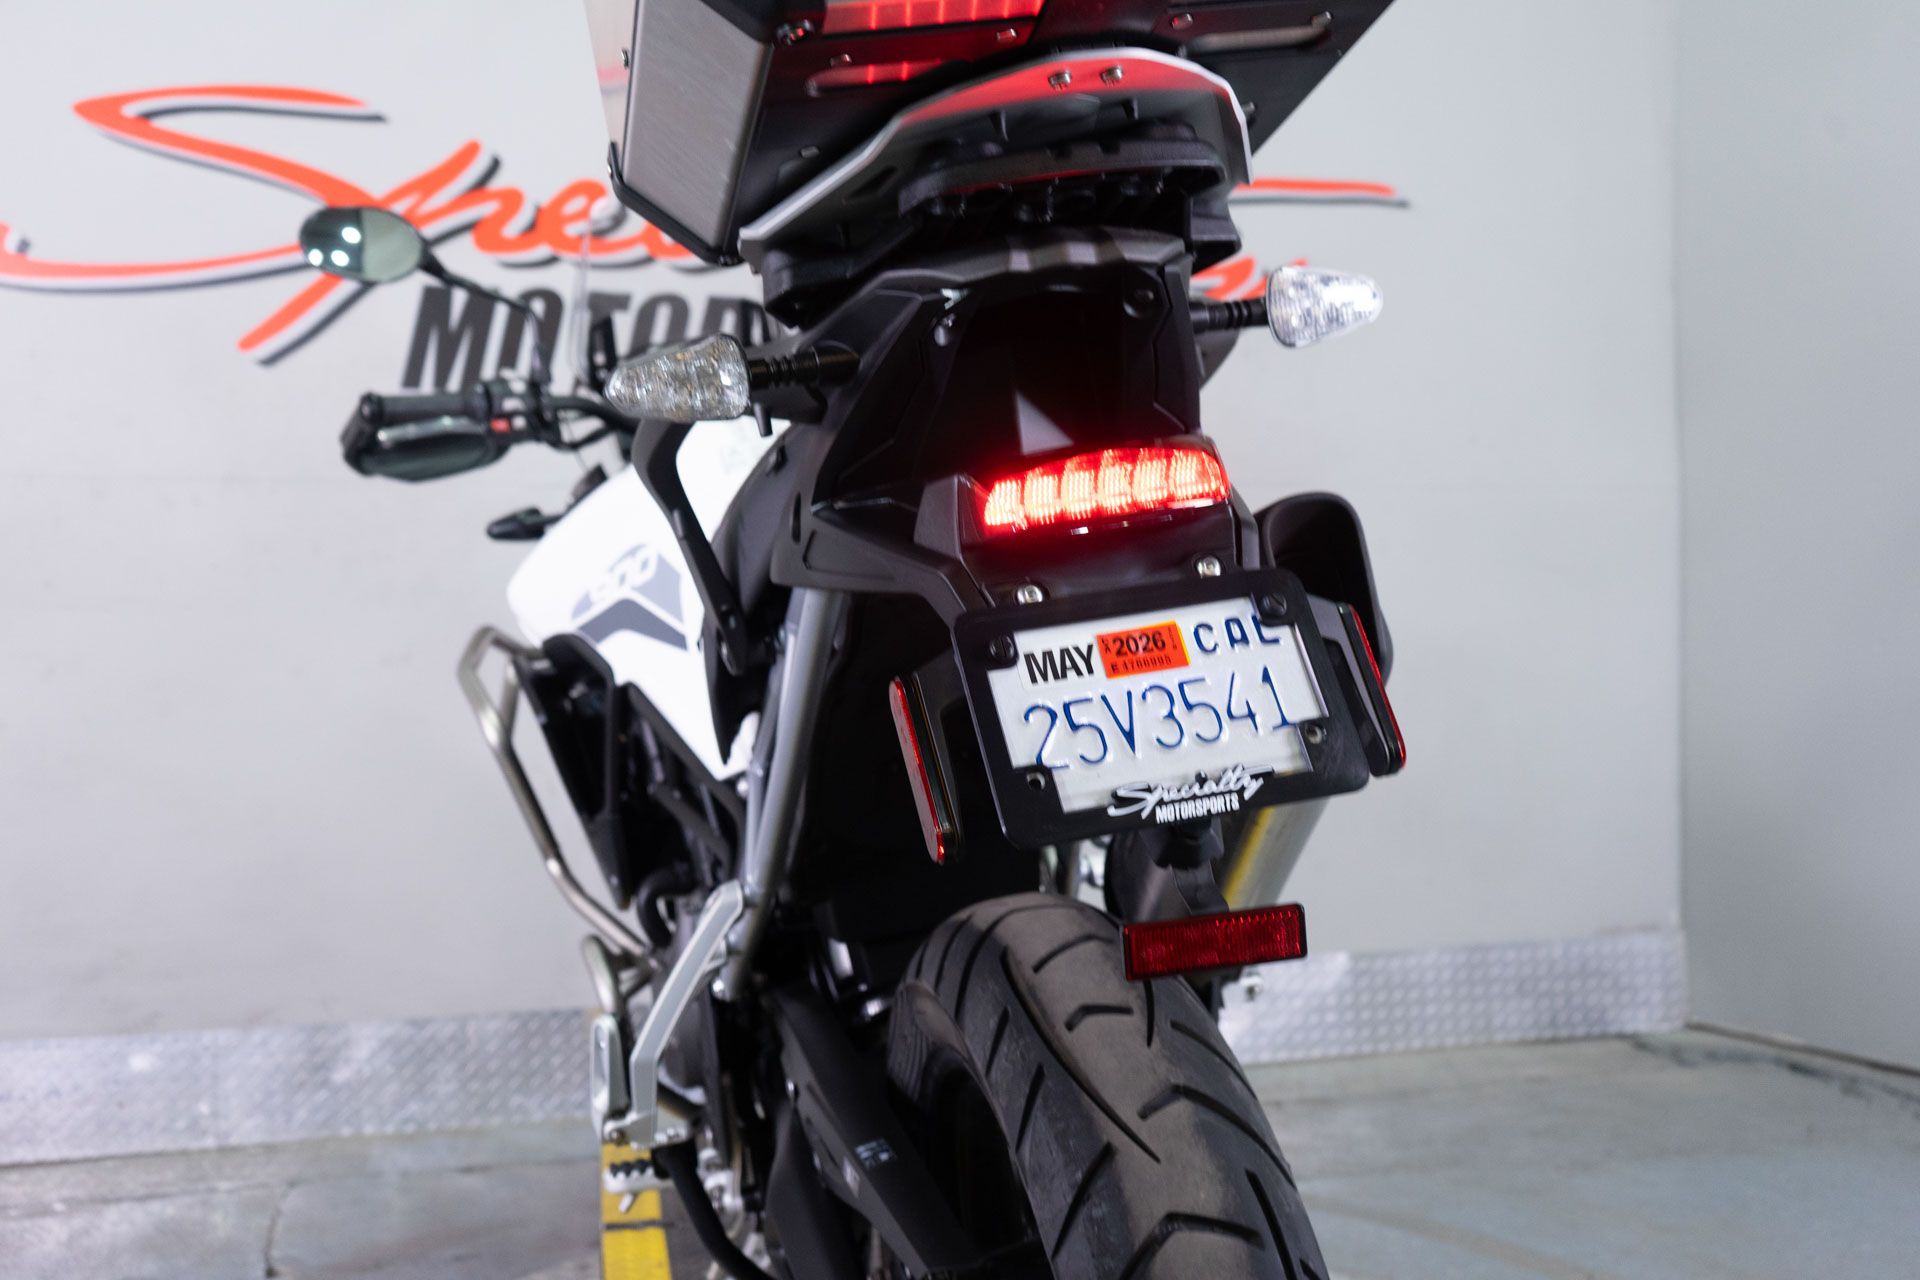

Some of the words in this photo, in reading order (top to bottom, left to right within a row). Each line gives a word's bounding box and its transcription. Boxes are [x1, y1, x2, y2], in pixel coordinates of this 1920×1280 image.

[1112, 630, 1166, 657] 2026
[1193, 613, 1280, 653] CAL
[1023, 643, 1095, 685] MAY
[1023, 665, 1300, 770] 25V3541
[1106, 762, 1274, 820] Specialty
[1155, 792, 1240, 824] MOTORSPORTS
